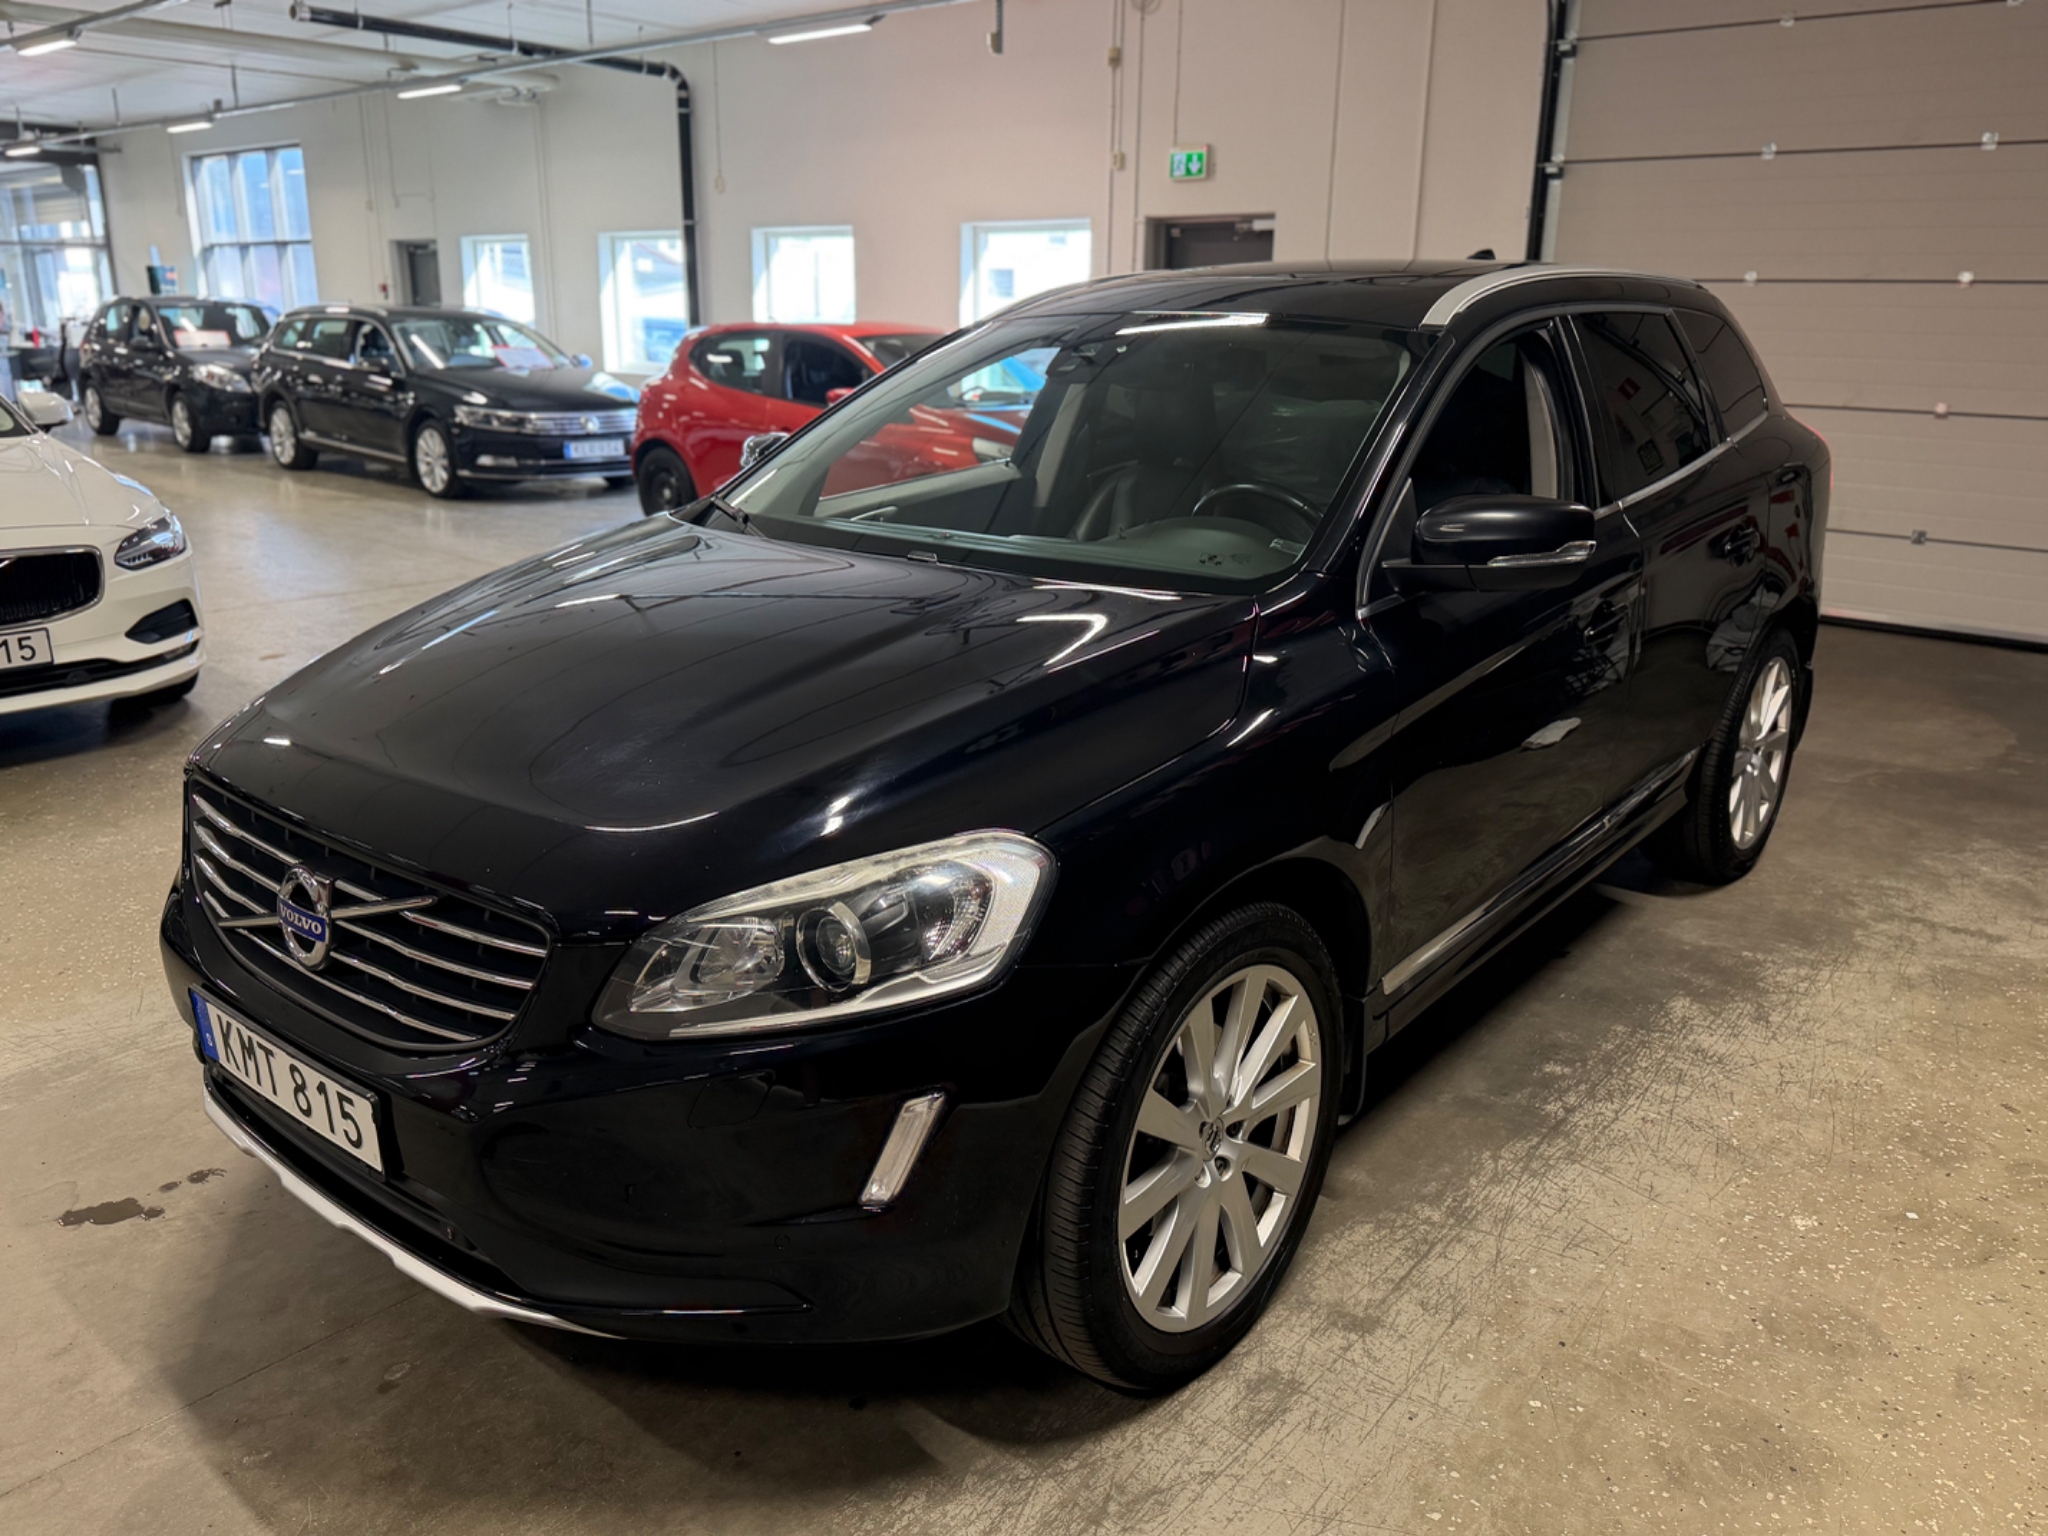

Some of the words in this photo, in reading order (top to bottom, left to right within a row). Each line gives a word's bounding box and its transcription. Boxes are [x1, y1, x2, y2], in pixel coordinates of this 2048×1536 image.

[279, 904, 323, 935] VOLVO
[216, 1013, 278, 1097] KMT
[289, 1063, 363, 1149] 815
